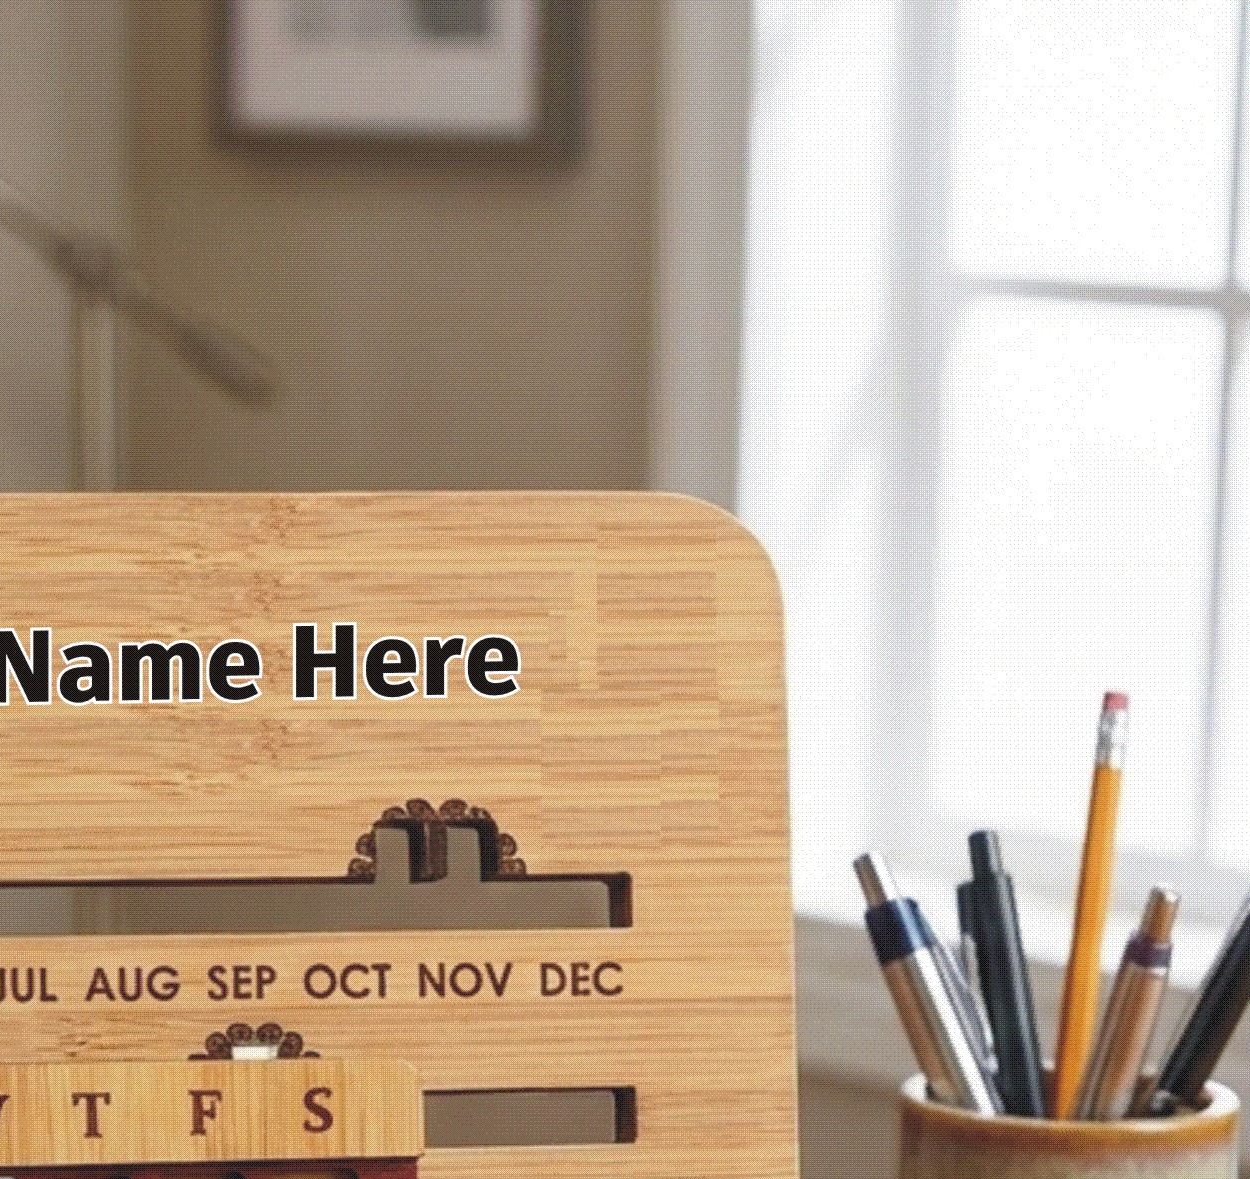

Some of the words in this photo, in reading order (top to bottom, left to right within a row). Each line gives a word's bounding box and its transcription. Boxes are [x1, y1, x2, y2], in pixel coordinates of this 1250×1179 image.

[85, 967, 181, 1002] AUG
[207, 965, 277, 1001] SEP
[303, 963, 392, 1000] OCT
[418, 963, 513, 998] NOV
[540, 962, 624, 997] DEC
[72, 1091, 110, 1138] T
[188, 1089, 223, 1136] F
[303, 1086, 335, 1133] S
